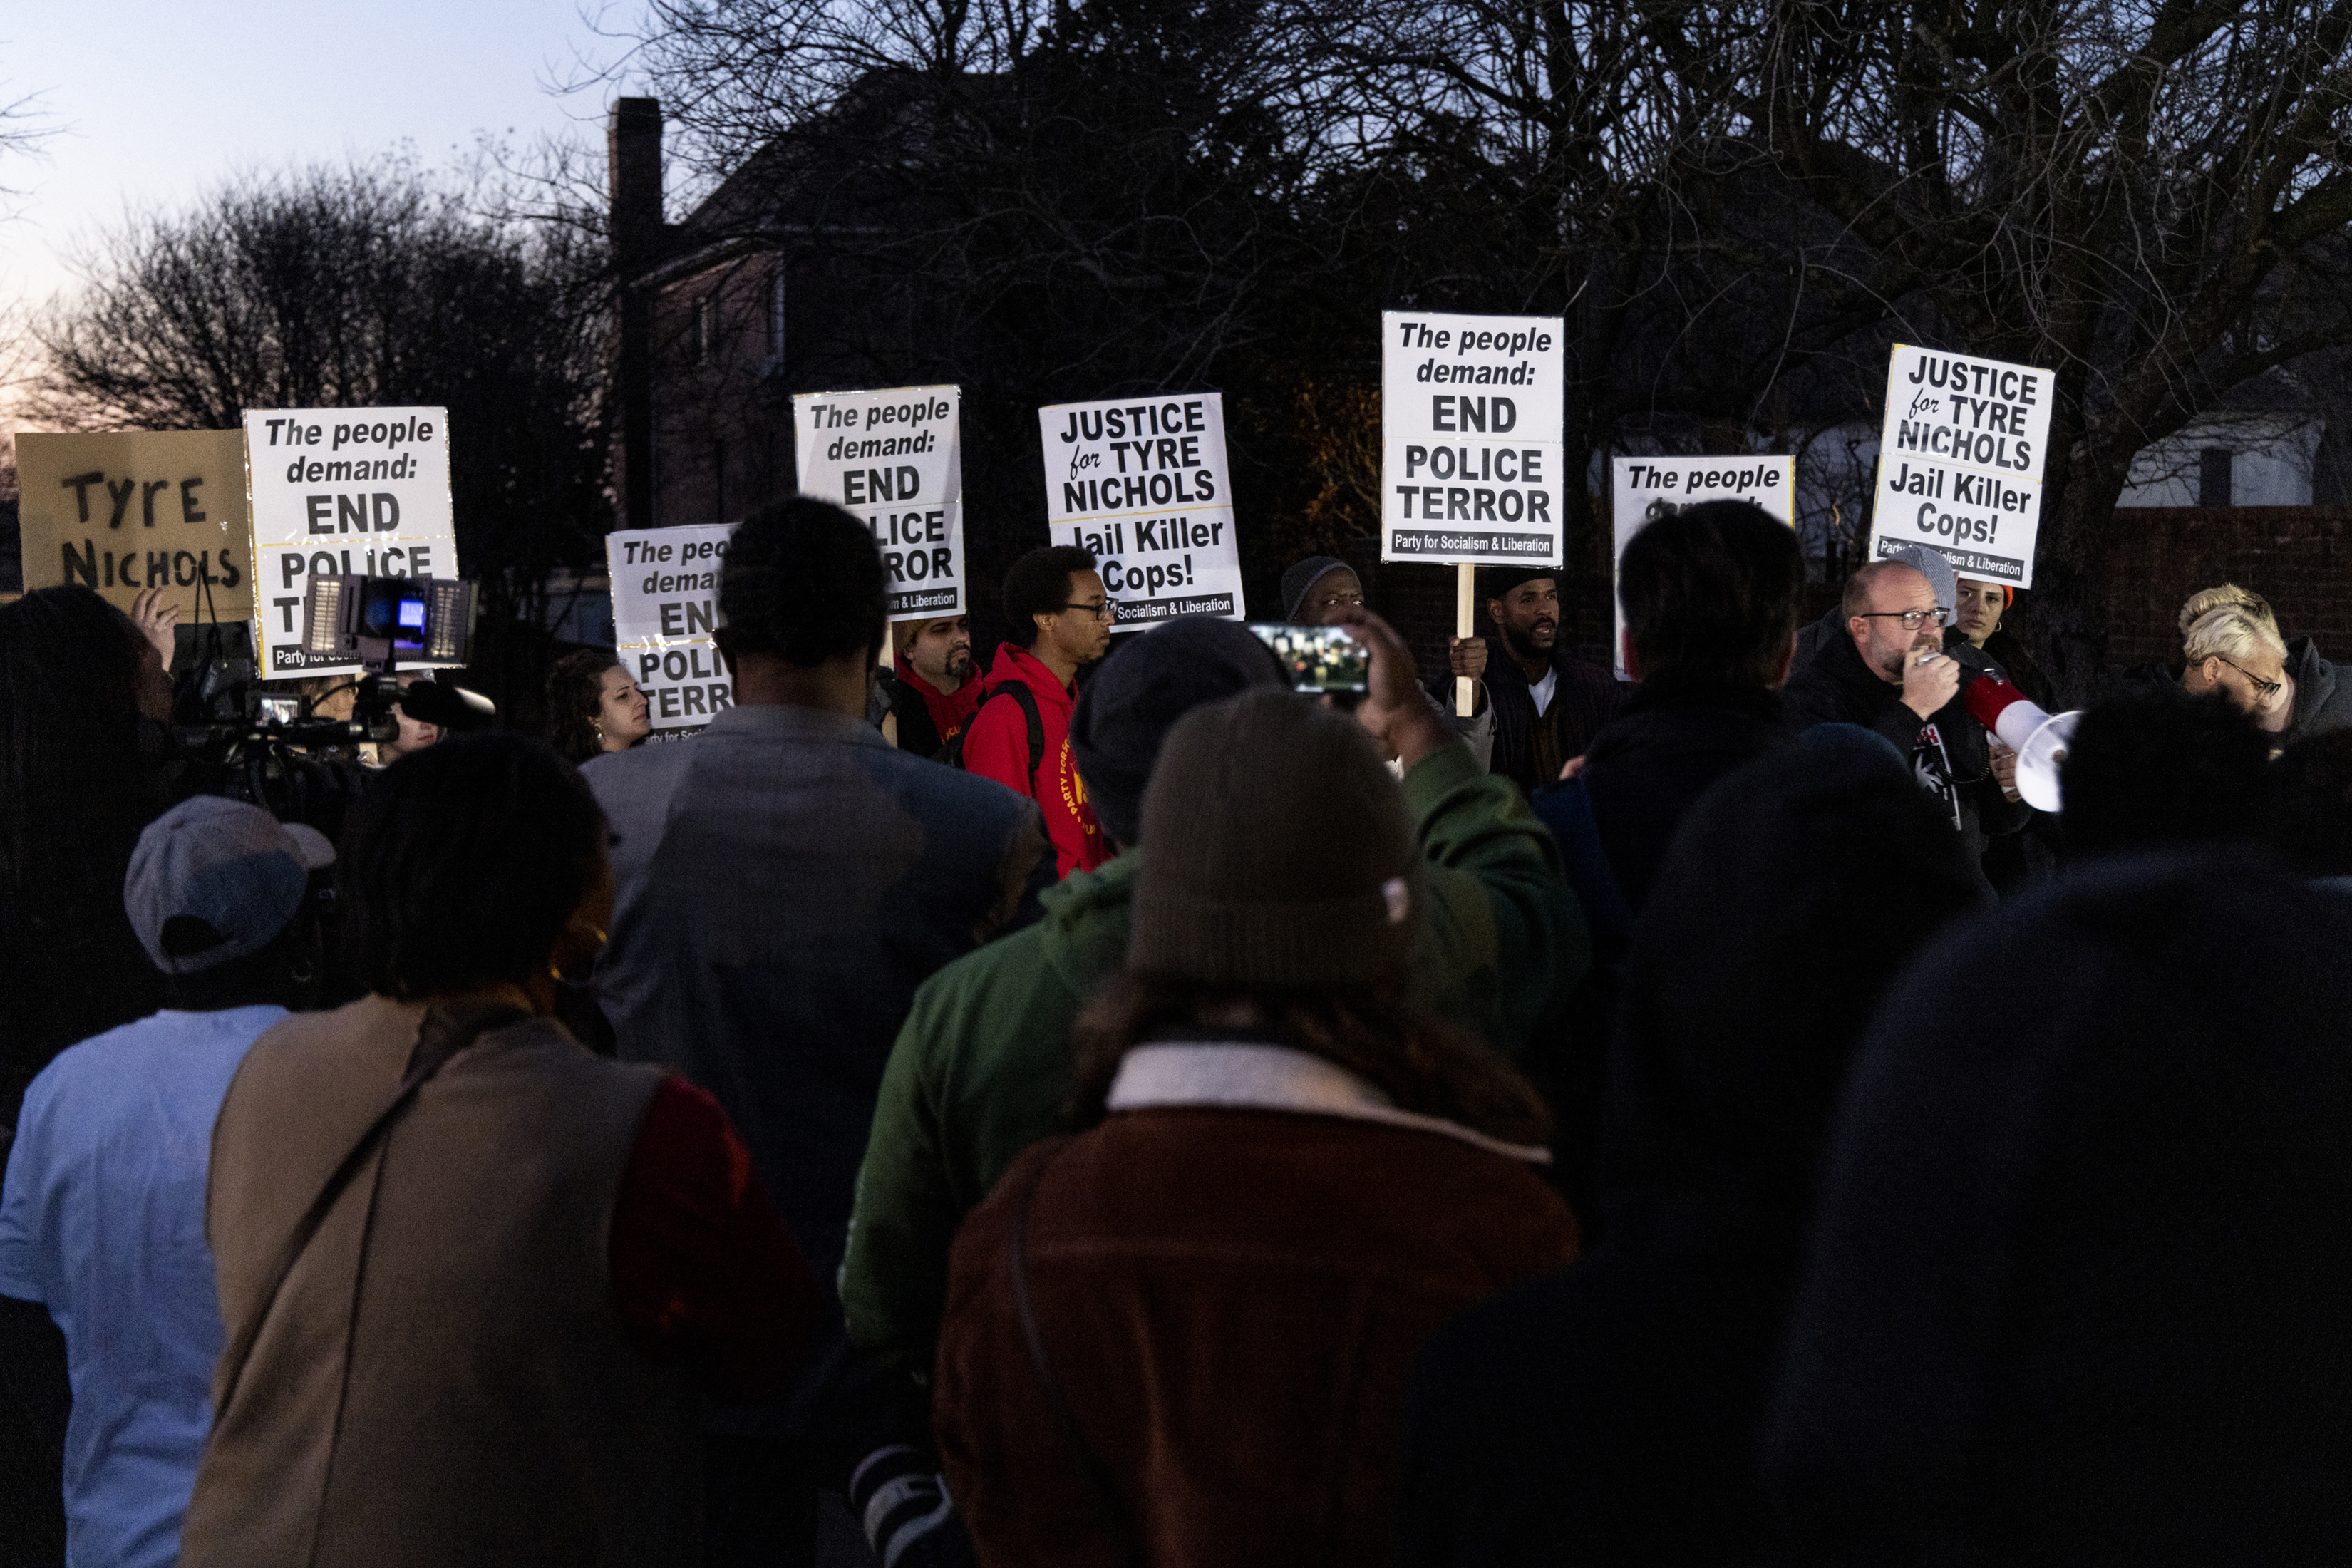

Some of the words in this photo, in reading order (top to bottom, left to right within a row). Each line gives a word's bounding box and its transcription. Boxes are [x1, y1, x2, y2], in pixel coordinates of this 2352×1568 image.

[1398, 322, 1450, 349] The
[1458, 326, 1552, 357] people
[1416, 358, 1535, 386] demand:
[1909, 355, 2037, 406] JUSTICE
[810, 405, 858, 429] The
[867, 397, 949, 430] people
[1060, 401, 1205, 443] JUSTICE
[1433, 395, 1517, 433] END
[1909, 388, 1939, 419] for
[1949, 394, 2028, 437] TYRE
[266, 419, 321, 446] The
[332, 416, 433, 450] people
[827, 430, 934, 460] demand:
[1897, 419, 2031, 471] NICHOLS
[287, 453, 416, 483] demand:
[1070, 445, 1101, 481] for
[1110, 435, 1201, 473] TYRE
[1405, 445, 1542, 483] POLICE
[843, 465, 919, 505] END
[1063, 470, 1214, 514] NICHOLS
[1629, 466, 1678, 488] The
[1686, 465, 1780, 494] people
[1890, 463, 1944, 499] Jail
[1954, 473, 2031, 513] Killer
[306, 492, 399, 535] END
[1397, 486, 1551, 524] TERROR
[870, 510, 944, 546] LICE
[1135, 517, 1223, 552] Killer
[1917, 502, 1998, 546] Cops!
[624, 540, 672, 564] The
[681, 540, 730, 566] peo
[1396, 534, 1421, 551] Party
[1424, 535, 1438, 550] for
[1440, 535, 1488, 550] Socialism
[1491, 537, 1499, 550] &
[1502, 537, 1550, 552] Liberation
[62, 538, 240, 590] NICHOLS
[884, 547, 954, 582] ROR
[1103, 554, 1193, 597] Cops!
[1967, 555, 1974, 567] &
[1977, 557, 2020, 576] Liberation
[643, 571, 716, 594] dema
[902, 597, 908, 608] &
[910, 593, 954, 607] Liberation
[1118, 604, 1167, 619] Socialism
[1170, 602, 1177, 615] &
[1180, 598, 1230, 614] Liberation
[276, 649, 306, 666] Party
[639, 647, 722, 684] POLI
[641, 683, 732, 718] TERR
[1060, 778, 1078, 815] PARTY
